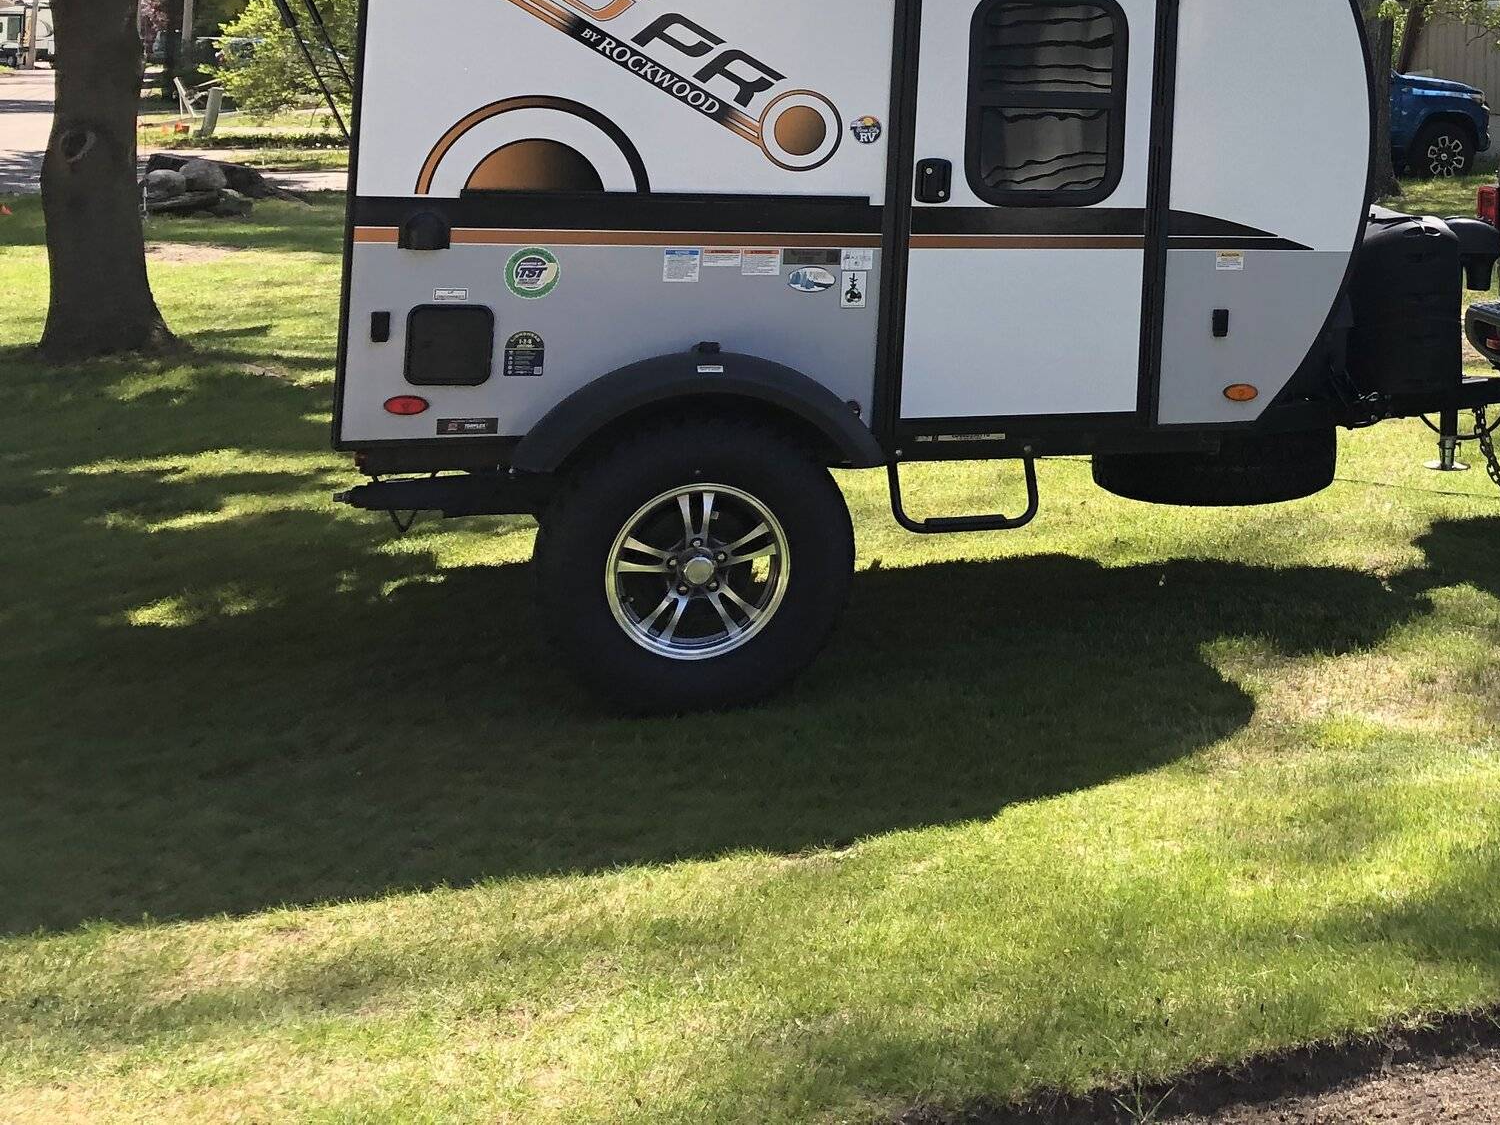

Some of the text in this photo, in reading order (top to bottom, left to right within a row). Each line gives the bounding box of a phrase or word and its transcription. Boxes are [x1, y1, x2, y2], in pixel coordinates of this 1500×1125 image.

[580, 28, 720, 114] BY ROCKWOOD
[859, 132, 876, 142] RV
[517, 266, 548, 279] TST
